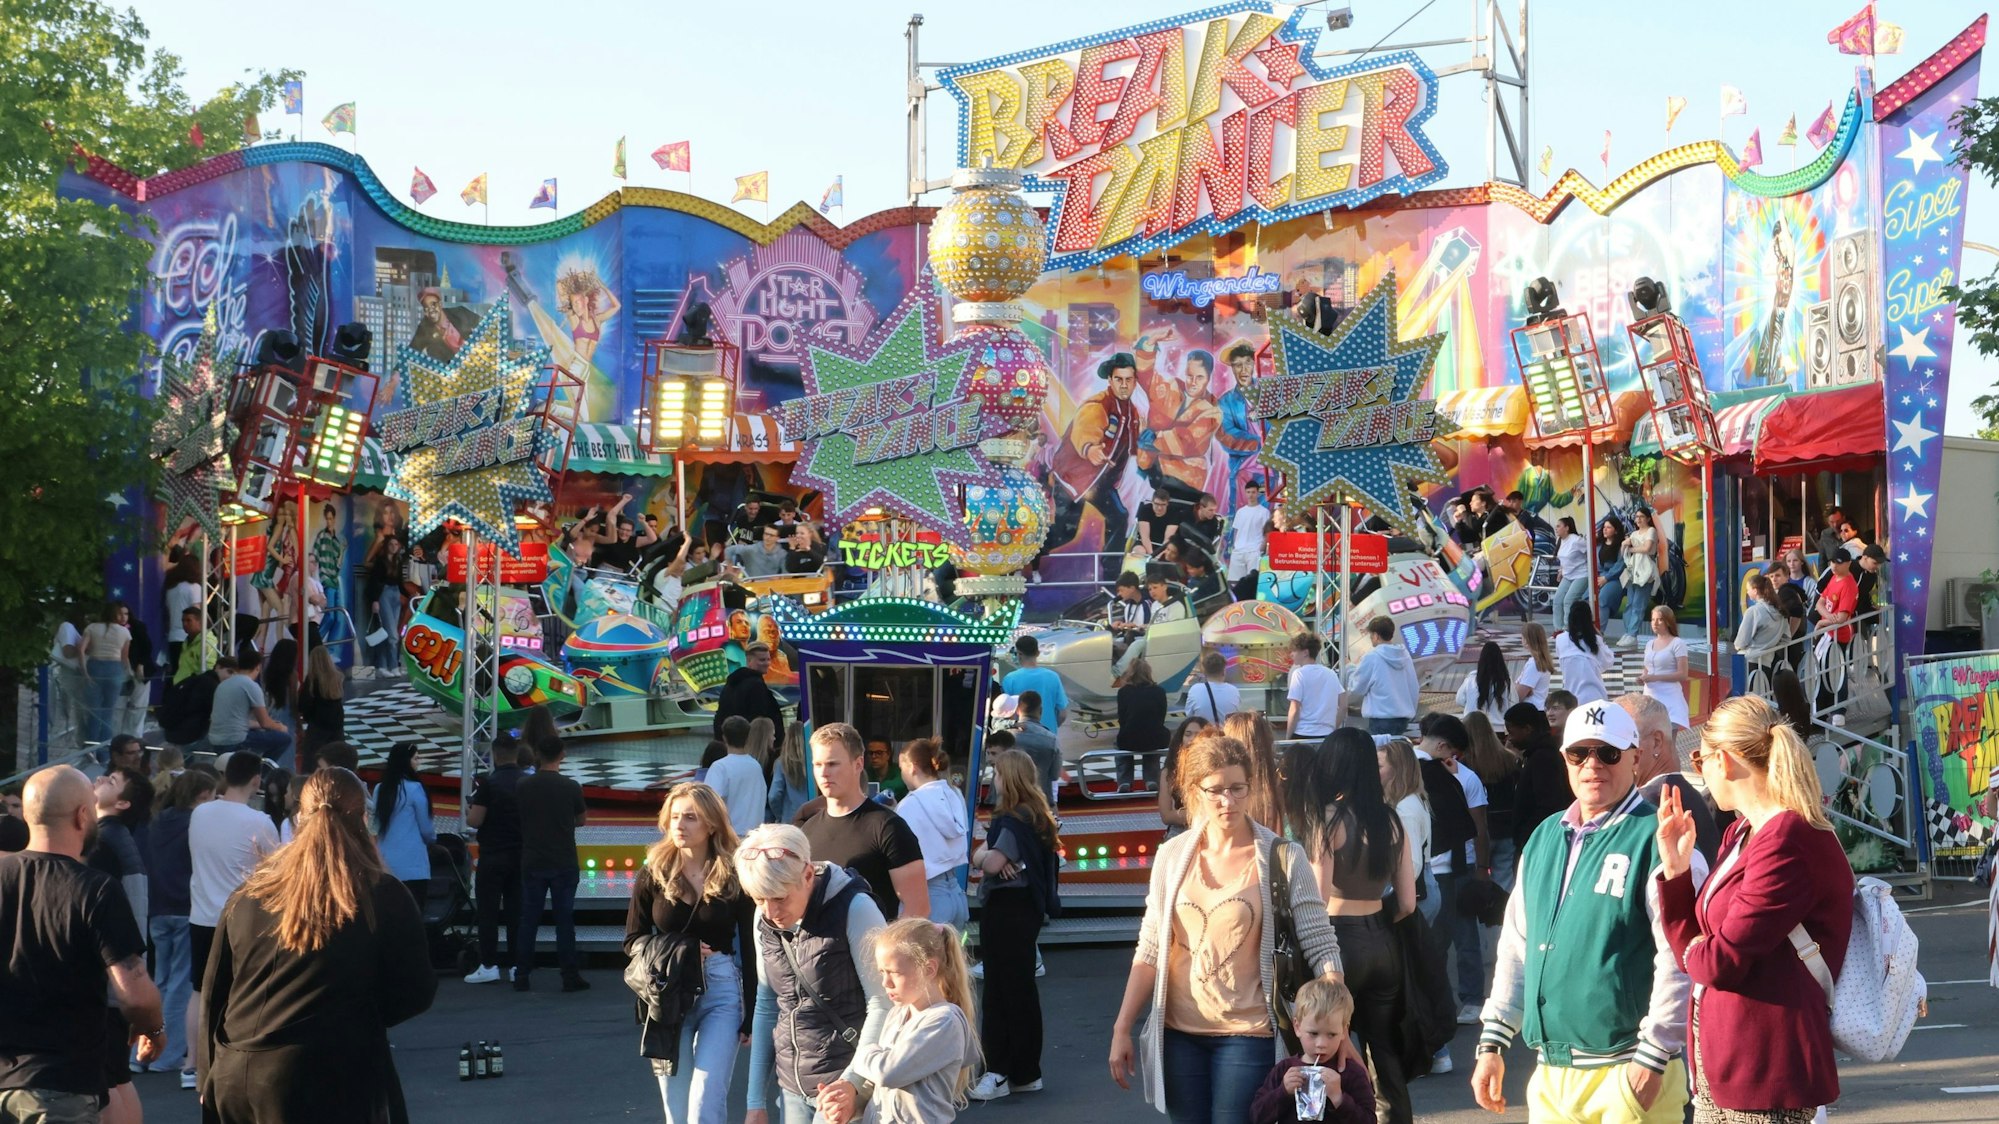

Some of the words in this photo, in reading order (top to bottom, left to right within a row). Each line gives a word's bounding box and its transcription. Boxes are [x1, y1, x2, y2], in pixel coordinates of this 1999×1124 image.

[953, 12, 1286, 169] BREAK
[1044, 67, 1435, 253] DANCER
[1884, 177, 1962, 240] Super
[759, 289, 839, 320] LIGHT
[1142, 265, 1281, 308] Wingender
[780, 378, 915, 441] BREAK
[1257, 367, 1378, 419] BREAK
[381, 392, 485, 452] BREAK
[424, 415, 536, 476] DANCE
[736, 433, 769, 448] KRASS
[839, 401, 982, 466] DANCE
[1308, 399, 1437, 450] DANCE
[572, 440, 590, 458] THE
[592, 441, 613, 459] BEST
[615, 444, 631, 460] HIT
[838, 540, 950, 570] TICKETS
[1398, 562, 1440, 588] VIP
[404, 624, 464, 684] GOAL!
[1584, 706, 1606, 725] NY
[1593, 853, 1631, 899] R
